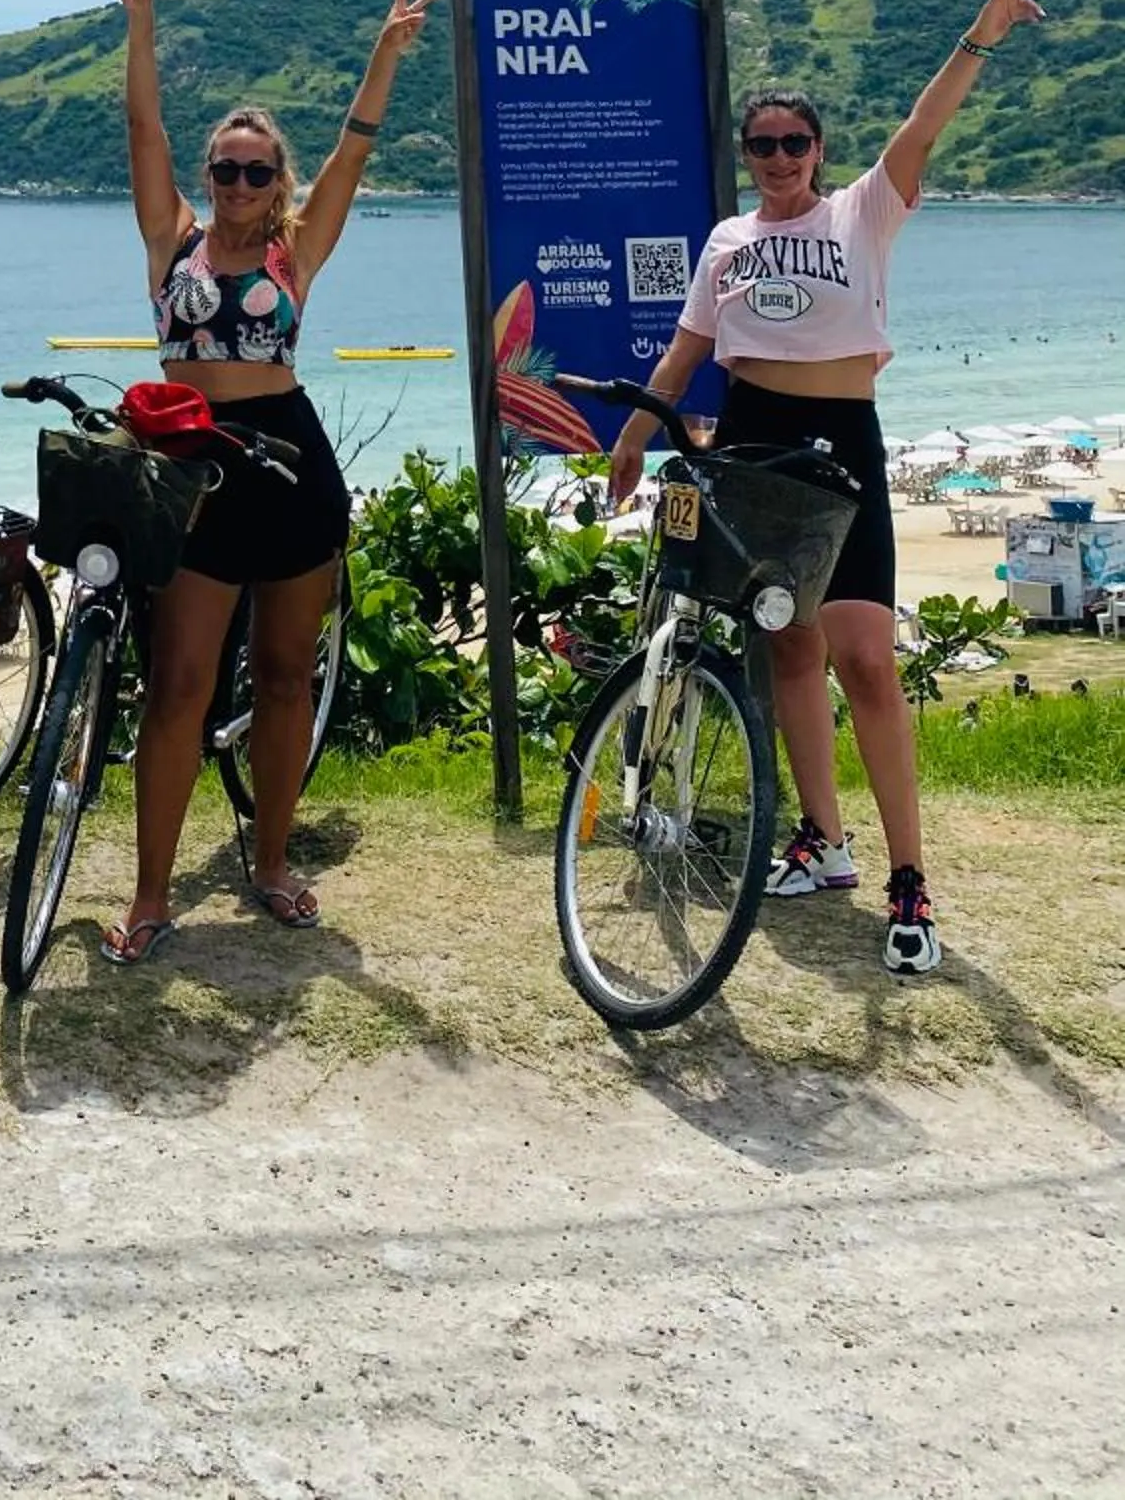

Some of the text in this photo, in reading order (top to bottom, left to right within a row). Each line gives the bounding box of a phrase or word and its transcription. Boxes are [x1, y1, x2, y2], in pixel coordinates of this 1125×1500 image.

[494, 8, 607, 39] PRAI-
[496, 45, 590, 75] NHA
[538, 243, 604, 258] ARRAIAL
[552, 257, 603, 269] DO CABO
[542, 280, 610, 295] TURISMO
[670, 496, 694, 526] 02
